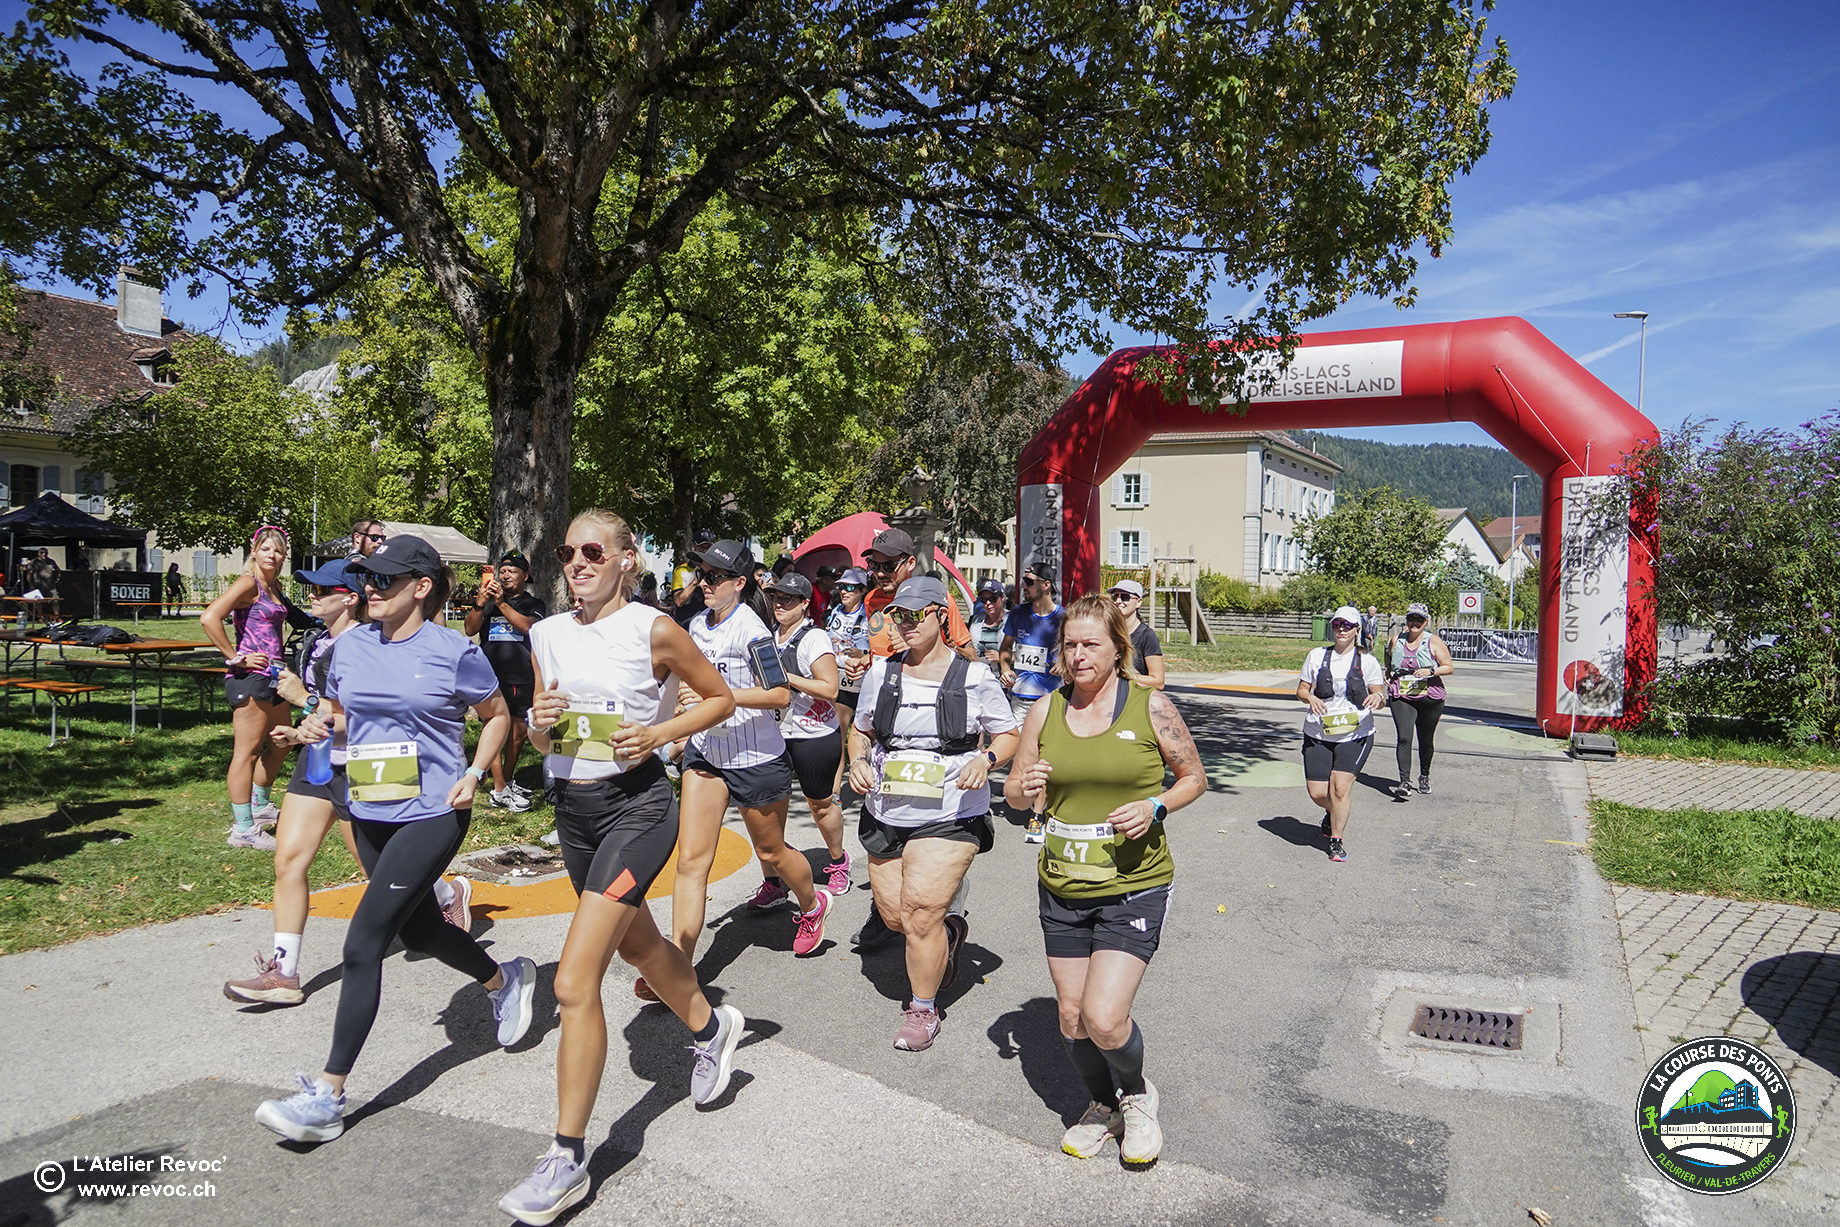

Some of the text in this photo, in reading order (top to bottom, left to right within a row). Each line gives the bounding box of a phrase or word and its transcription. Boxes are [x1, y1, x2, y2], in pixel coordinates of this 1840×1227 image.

[110, 586, 150, 599] BOXER
[499, 623, 513, 634] 33
[1021, 653, 1040, 667] 142
[840, 677, 854, 688] 69
[799, 707, 837, 727] adida
[1332, 714, 1348, 726] 44
[577, 715, 592, 739] 8
[371, 760, 386, 783] 7
[900, 763, 926, 782] 42
[365, 790, 398, 800] Florianne
[1063, 841, 1089, 863] 47
[1064, 867, 1094, 879] Delphine
